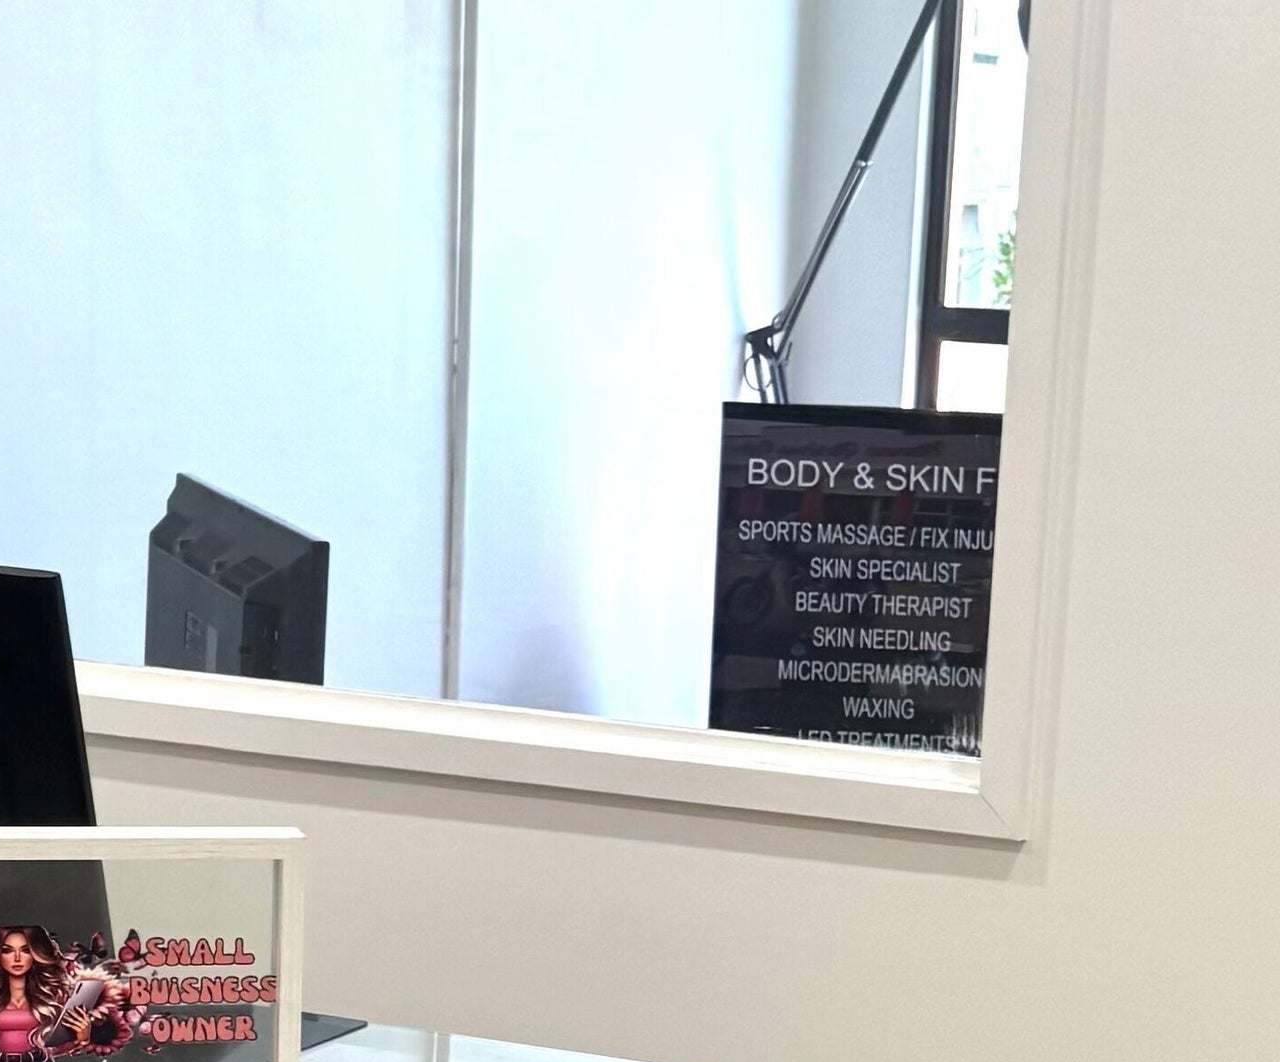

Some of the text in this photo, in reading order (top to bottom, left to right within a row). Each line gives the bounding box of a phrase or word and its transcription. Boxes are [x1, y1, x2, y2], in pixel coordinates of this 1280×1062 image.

[748, 458, 843, 489] BODY
[853, 462, 874, 490] &
[886, 463, 964, 494] SKIN
[738, 519, 812, 543] SPORTS
[817, 523, 905, 547] MASSAGE
[908, 526, 916, 548] /
[921, 527, 949, 549] FIX
[810, 557, 961, 584] SKIN SPECIALIST
[795, 591, 972, 619] BEAUTY THERAPIST
[812, 626, 951, 653] SKIN NEEDLING
[778, 660, 982, 688] MICRODERMABRASION
[843, 696, 915, 720] WAXING
[145, 937, 255, 966] SMALL
[152, 1014, 257, 1043] OWNER
